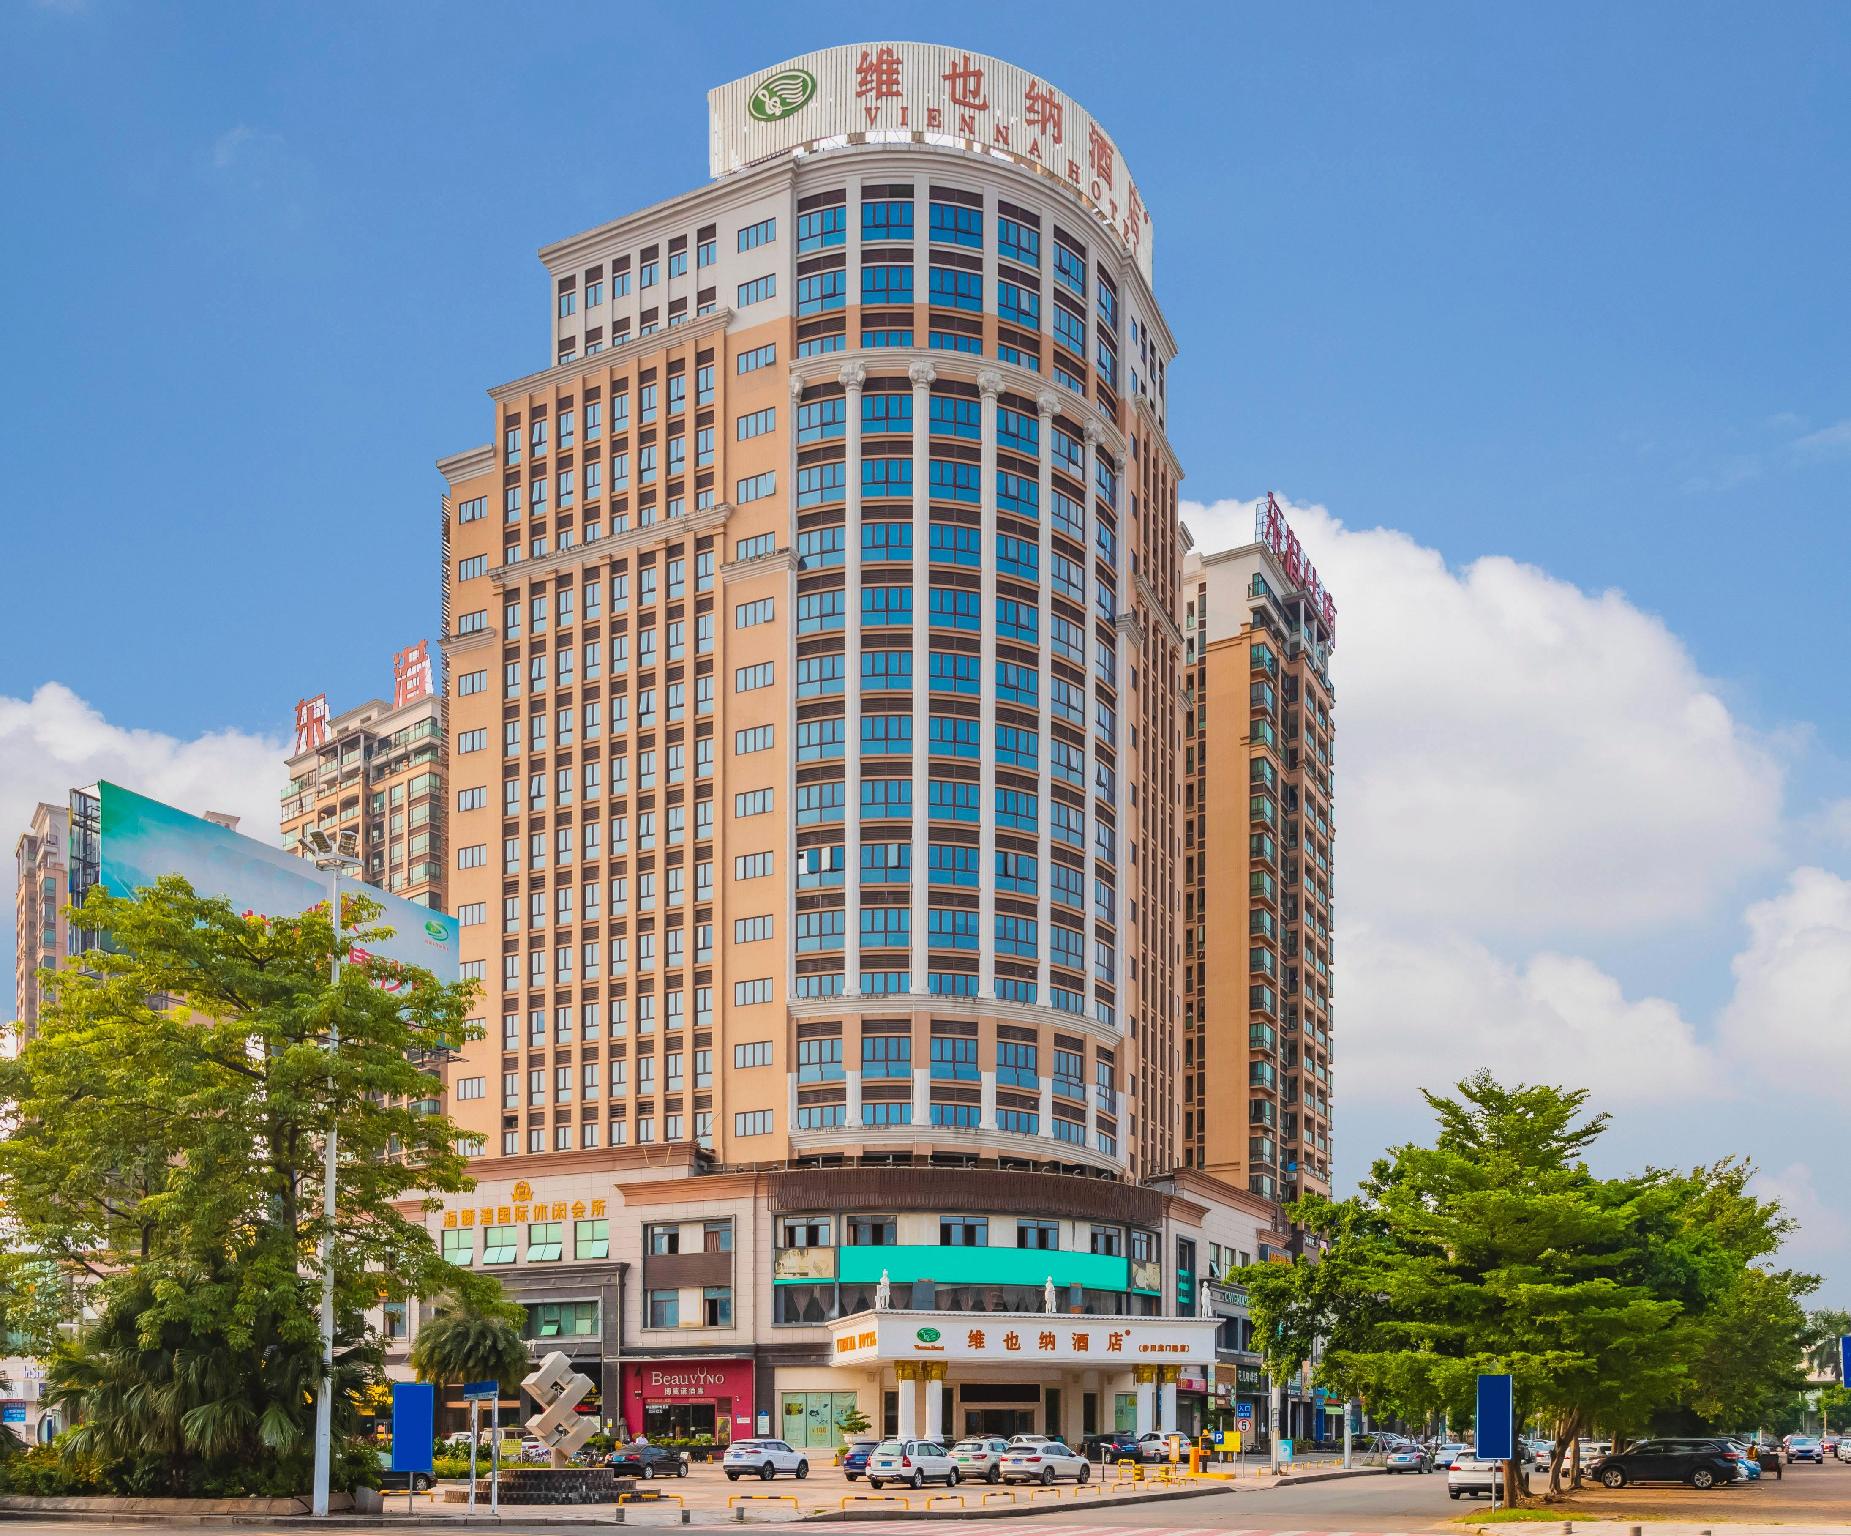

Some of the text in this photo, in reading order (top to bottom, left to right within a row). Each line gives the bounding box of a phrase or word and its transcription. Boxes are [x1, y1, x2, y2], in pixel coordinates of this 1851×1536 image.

[855, 47, 1142, 246] 维也纳酒店
[864, 106, 1042, 159] VIENNA
[967, 1329, 1124, 1352] 维也纳酒店
[1215, 1433, 1222, 1443] P
